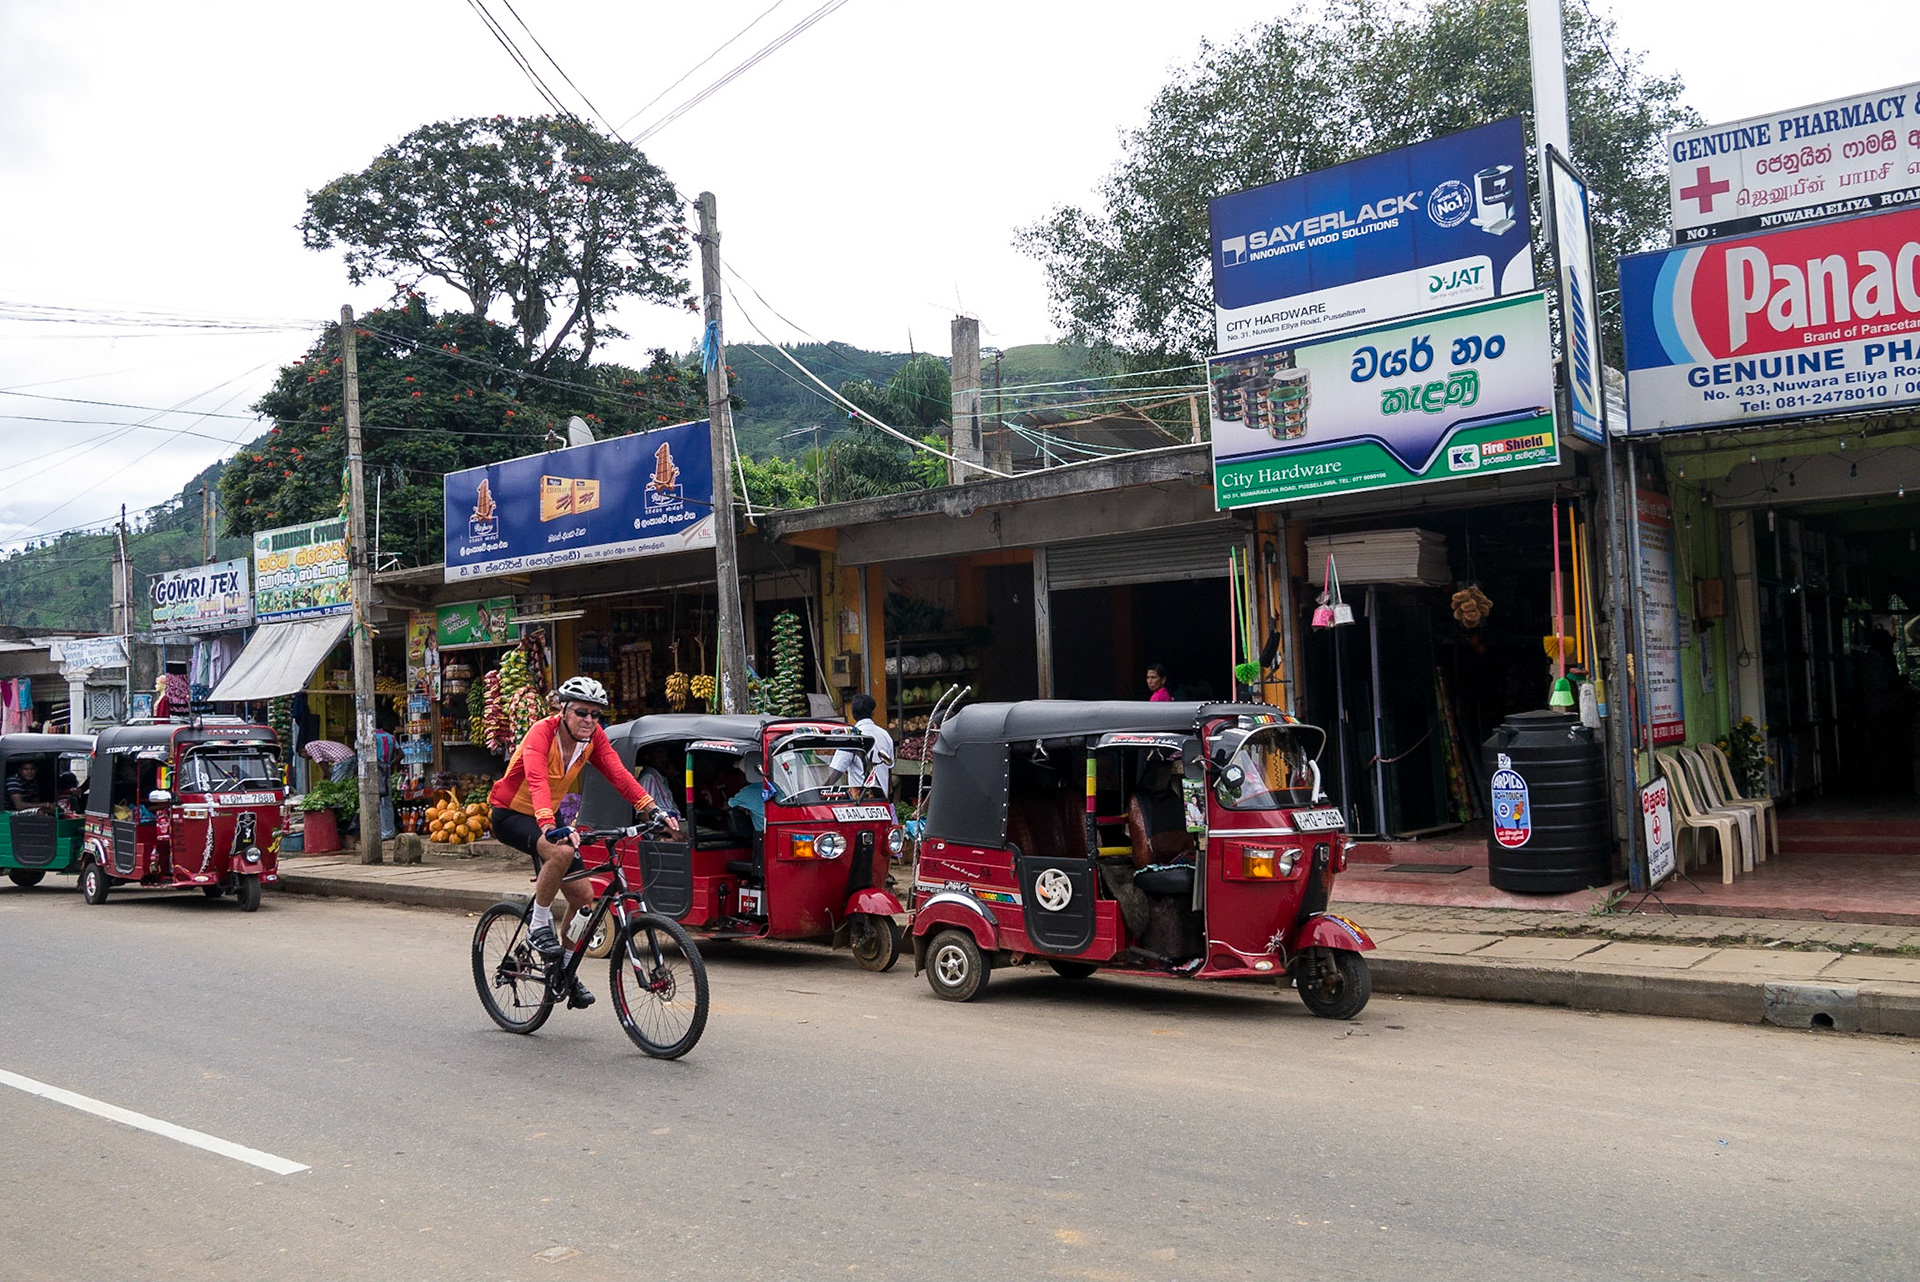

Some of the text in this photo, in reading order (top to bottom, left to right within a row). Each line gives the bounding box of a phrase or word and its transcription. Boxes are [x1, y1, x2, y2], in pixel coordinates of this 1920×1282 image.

[1673, 123, 1771, 164] GENUINE
[1779, 95, 1907, 142] PHARMACY
[1437, 194, 1463, 216] No.1
[1686, 227, 1709, 240] NO
[1760, 199, 1873, 228] NUWARAELIYA
[1880, 189, 1920, 206] ROA
[1250, 192, 1419, 252] SAYERLACK
[1250, 218, 1399, 262] INNOVATIVE WOOD SOLUTIONS
[1226, 303, 1327, 333] CITY HARDWARE
[1227, 307, 1366, 342] No. 31, Nuwara Eliya Road, Pussellawa
[1804, 319, 1920, 344] Brand of Paraceta
[1351, 334, 1434, 384] වයර්
[1688, 339, 1920, 388] GENUINE PH
[1703, 390, 1731, 402] No.
[1735, 384, 1771, 399] 433,
[1773, 376, 1839, 392] Nuwara
[1845, 370, 1888, 384] Eliya
[1741, 401, 1771, 413] Tel:
[1776, 386, 1888, 409] 081-2478010
[1482, 436, 1544, 456] Fire Shield
[1222, 459, 1342, 489] City Hardware
[156, 571, 239, 603] GOWRI TEX
[66, 656, 99, 669] PUBLIC
[106, 746, 129, 755] STORY
[147, 744, 166, 752] LIFE
[1493, 773, 1524, 790] ARPICO
[230, 794, 242, 804] QM
[252, 794, 275, 803] 7888
[867, 806, 889, 820] 0594
